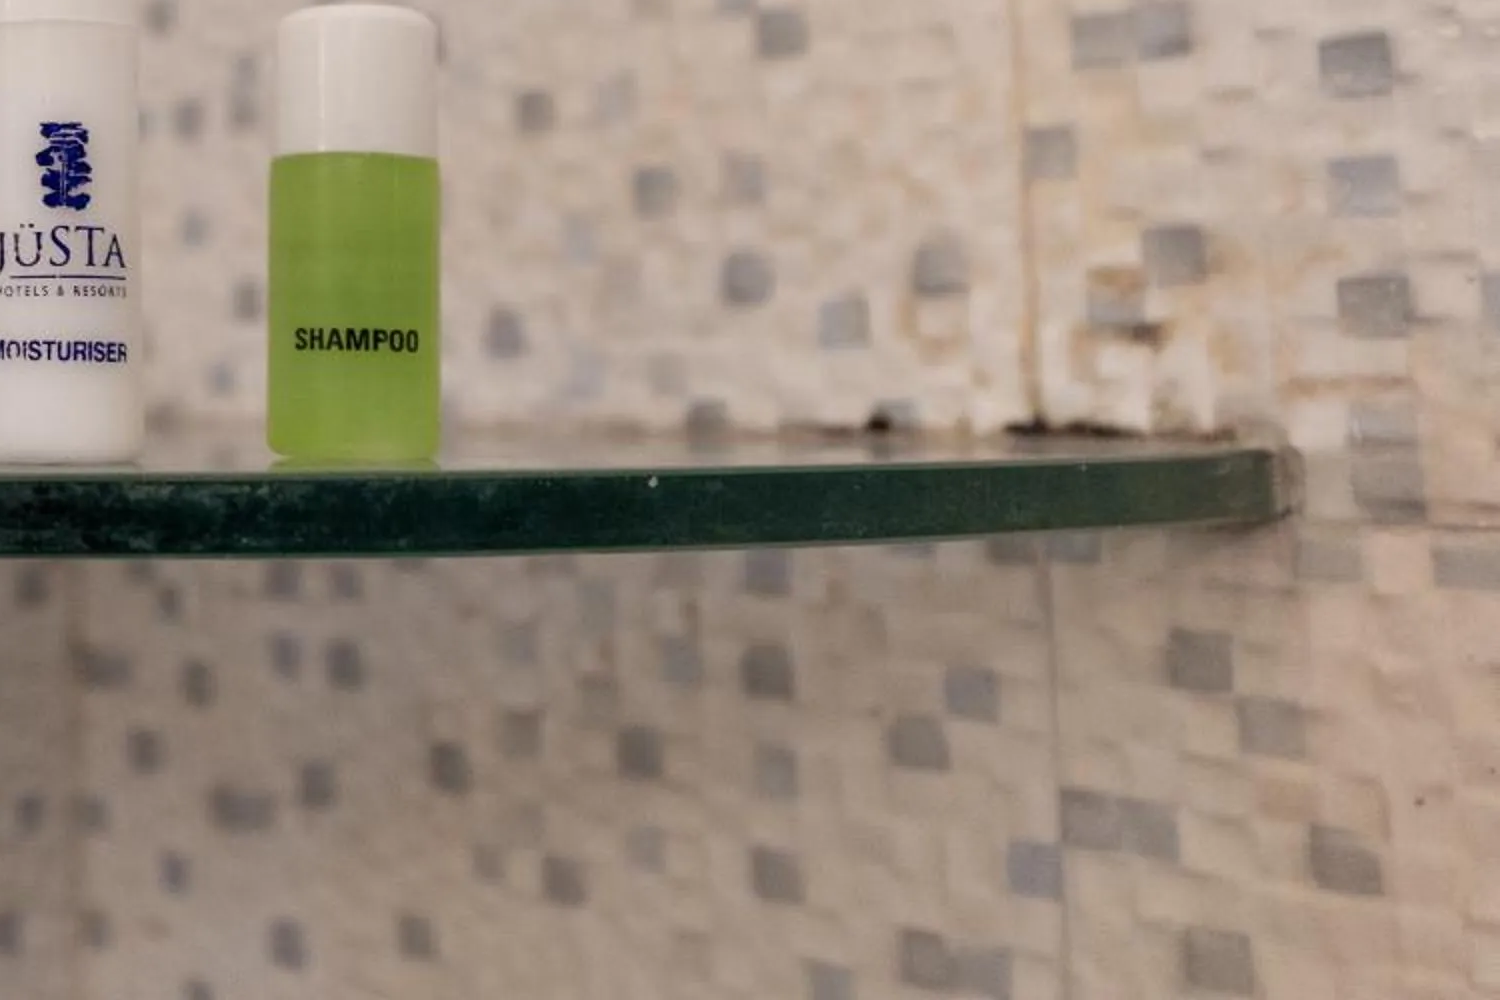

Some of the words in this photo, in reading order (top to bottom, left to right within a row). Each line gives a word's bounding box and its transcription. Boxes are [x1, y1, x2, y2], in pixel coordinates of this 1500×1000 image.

[56, 285, 64, 297] &
[73, 285, 127, 299] RESORTS
[294, 327, 419, 353] SHAMPOO
